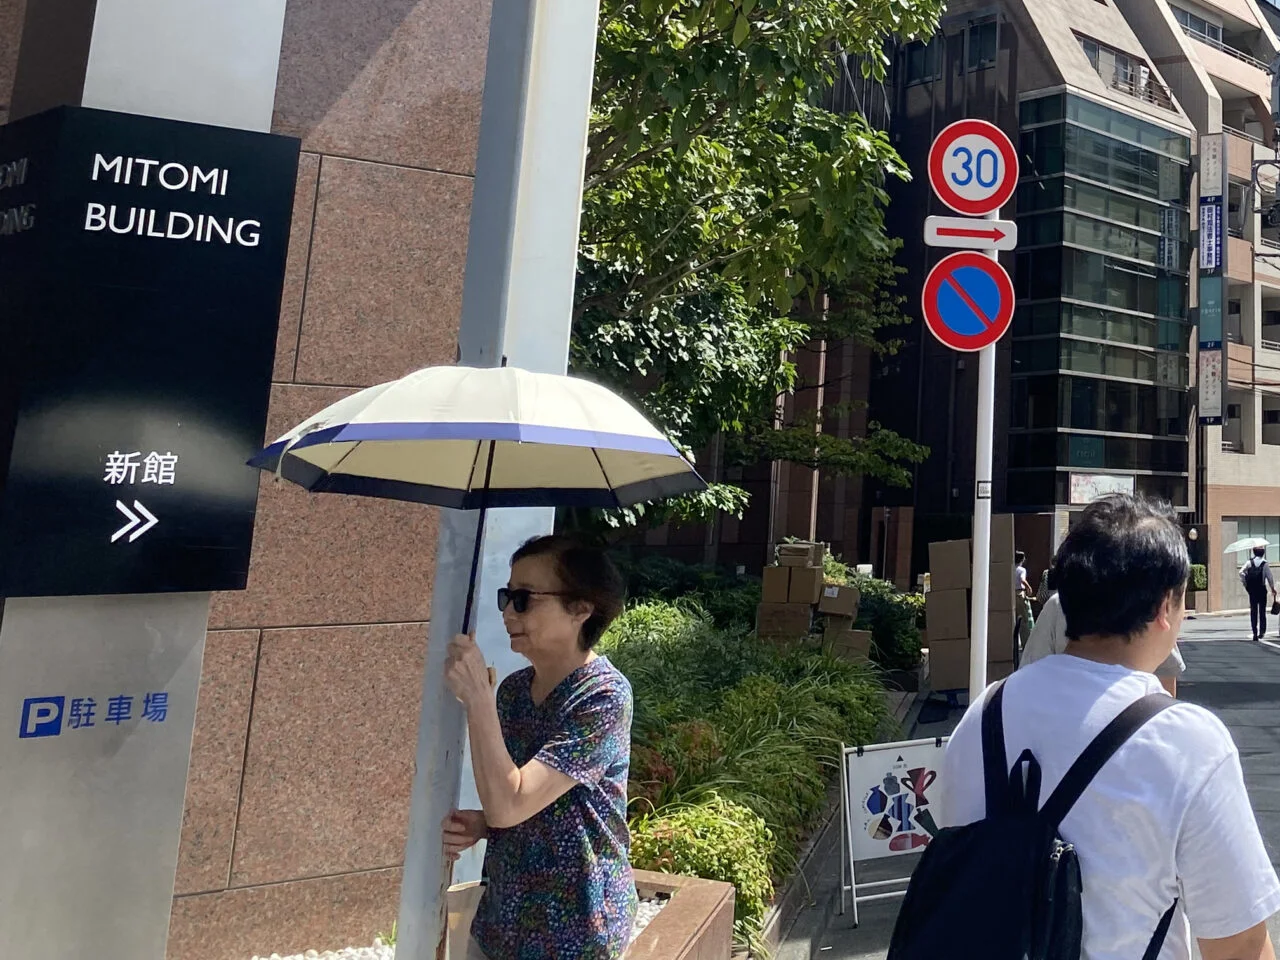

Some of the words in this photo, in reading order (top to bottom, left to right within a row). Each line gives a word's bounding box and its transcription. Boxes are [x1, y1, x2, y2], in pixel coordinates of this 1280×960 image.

[91, 153, 229, 196] MITOMI
[951, 146, 998, 188] 30
[84, 203, 261, 247] BUILDING
[103, 450, 178, 486] 新館
[66, 692, 170, 730] 駐車場
